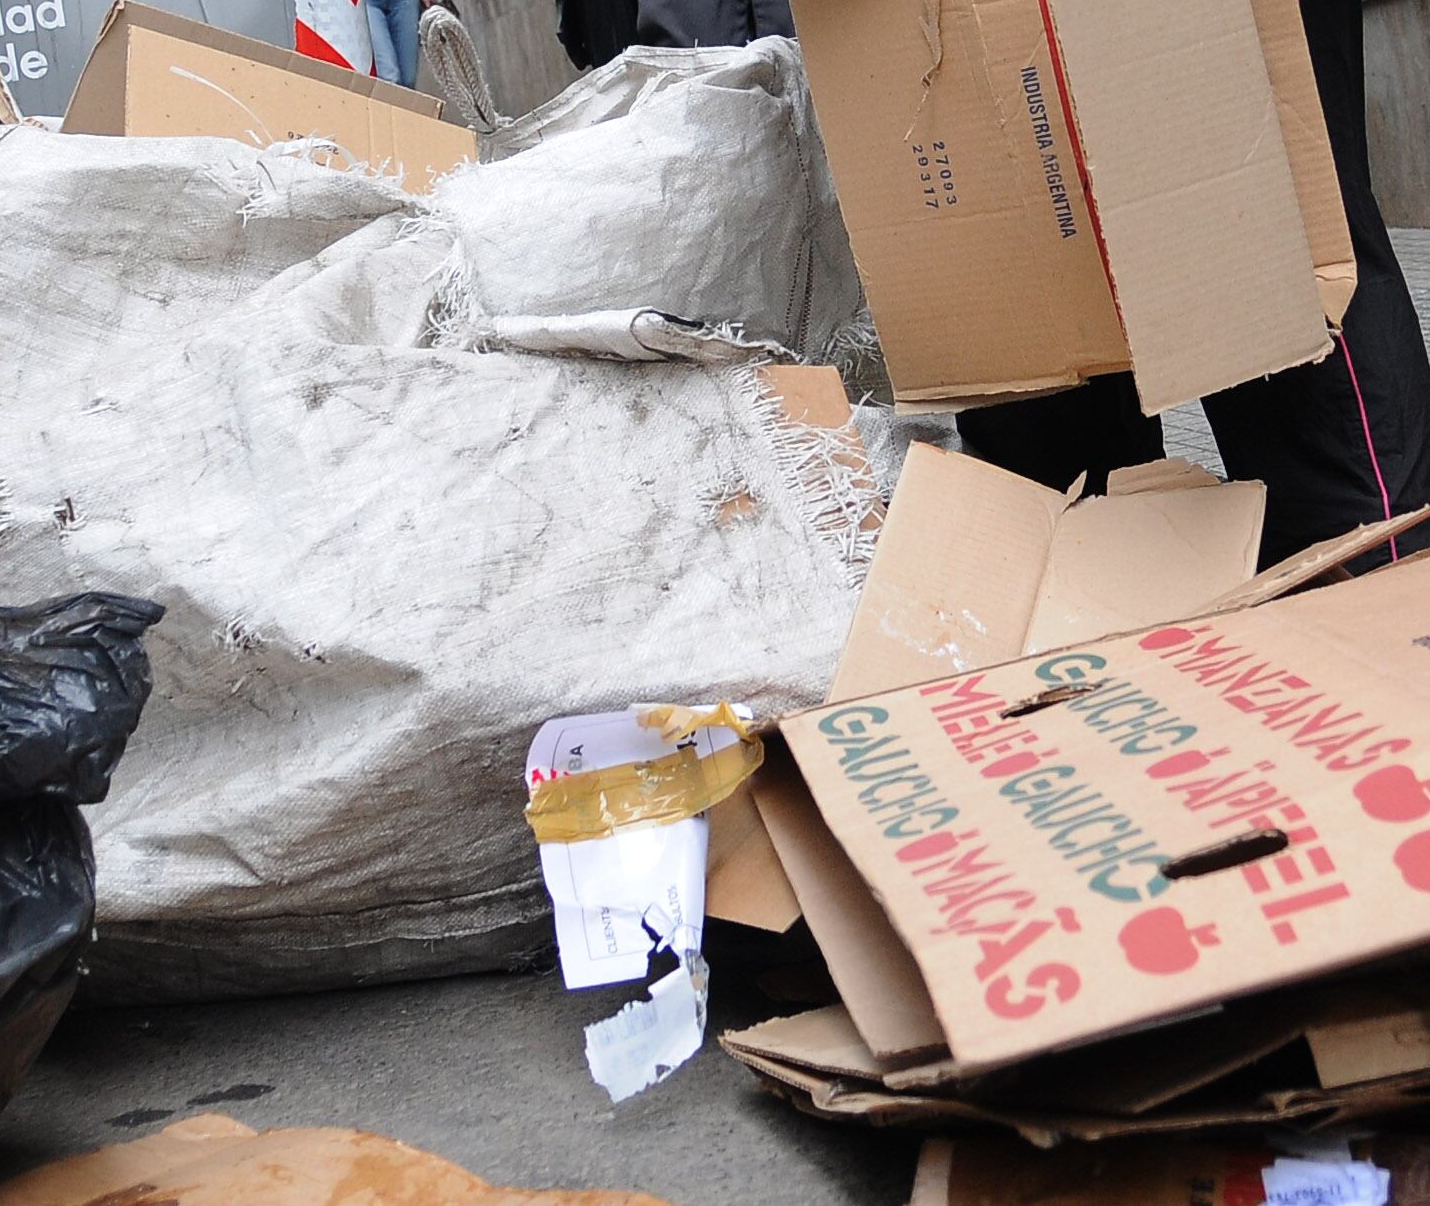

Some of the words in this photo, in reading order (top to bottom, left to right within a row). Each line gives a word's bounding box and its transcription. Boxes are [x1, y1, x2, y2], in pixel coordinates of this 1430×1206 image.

[913, 144, 939, 209] 29317
[932, 141, 958, 206] 27093
[1020, 65, 1053, 151] INDUSTRIA
[1040, 153, 1077, 239] ARGENTINA
[1035, 653, 1198, 755] GAUCHO
[1160, 635, 1412, 772] MANZANAS
[818, 706, 959, 839] GAUCHO
[911, 844, 1082, 1020] MAÇÃS
[998, 765, 1174, 902] GAUCHO
